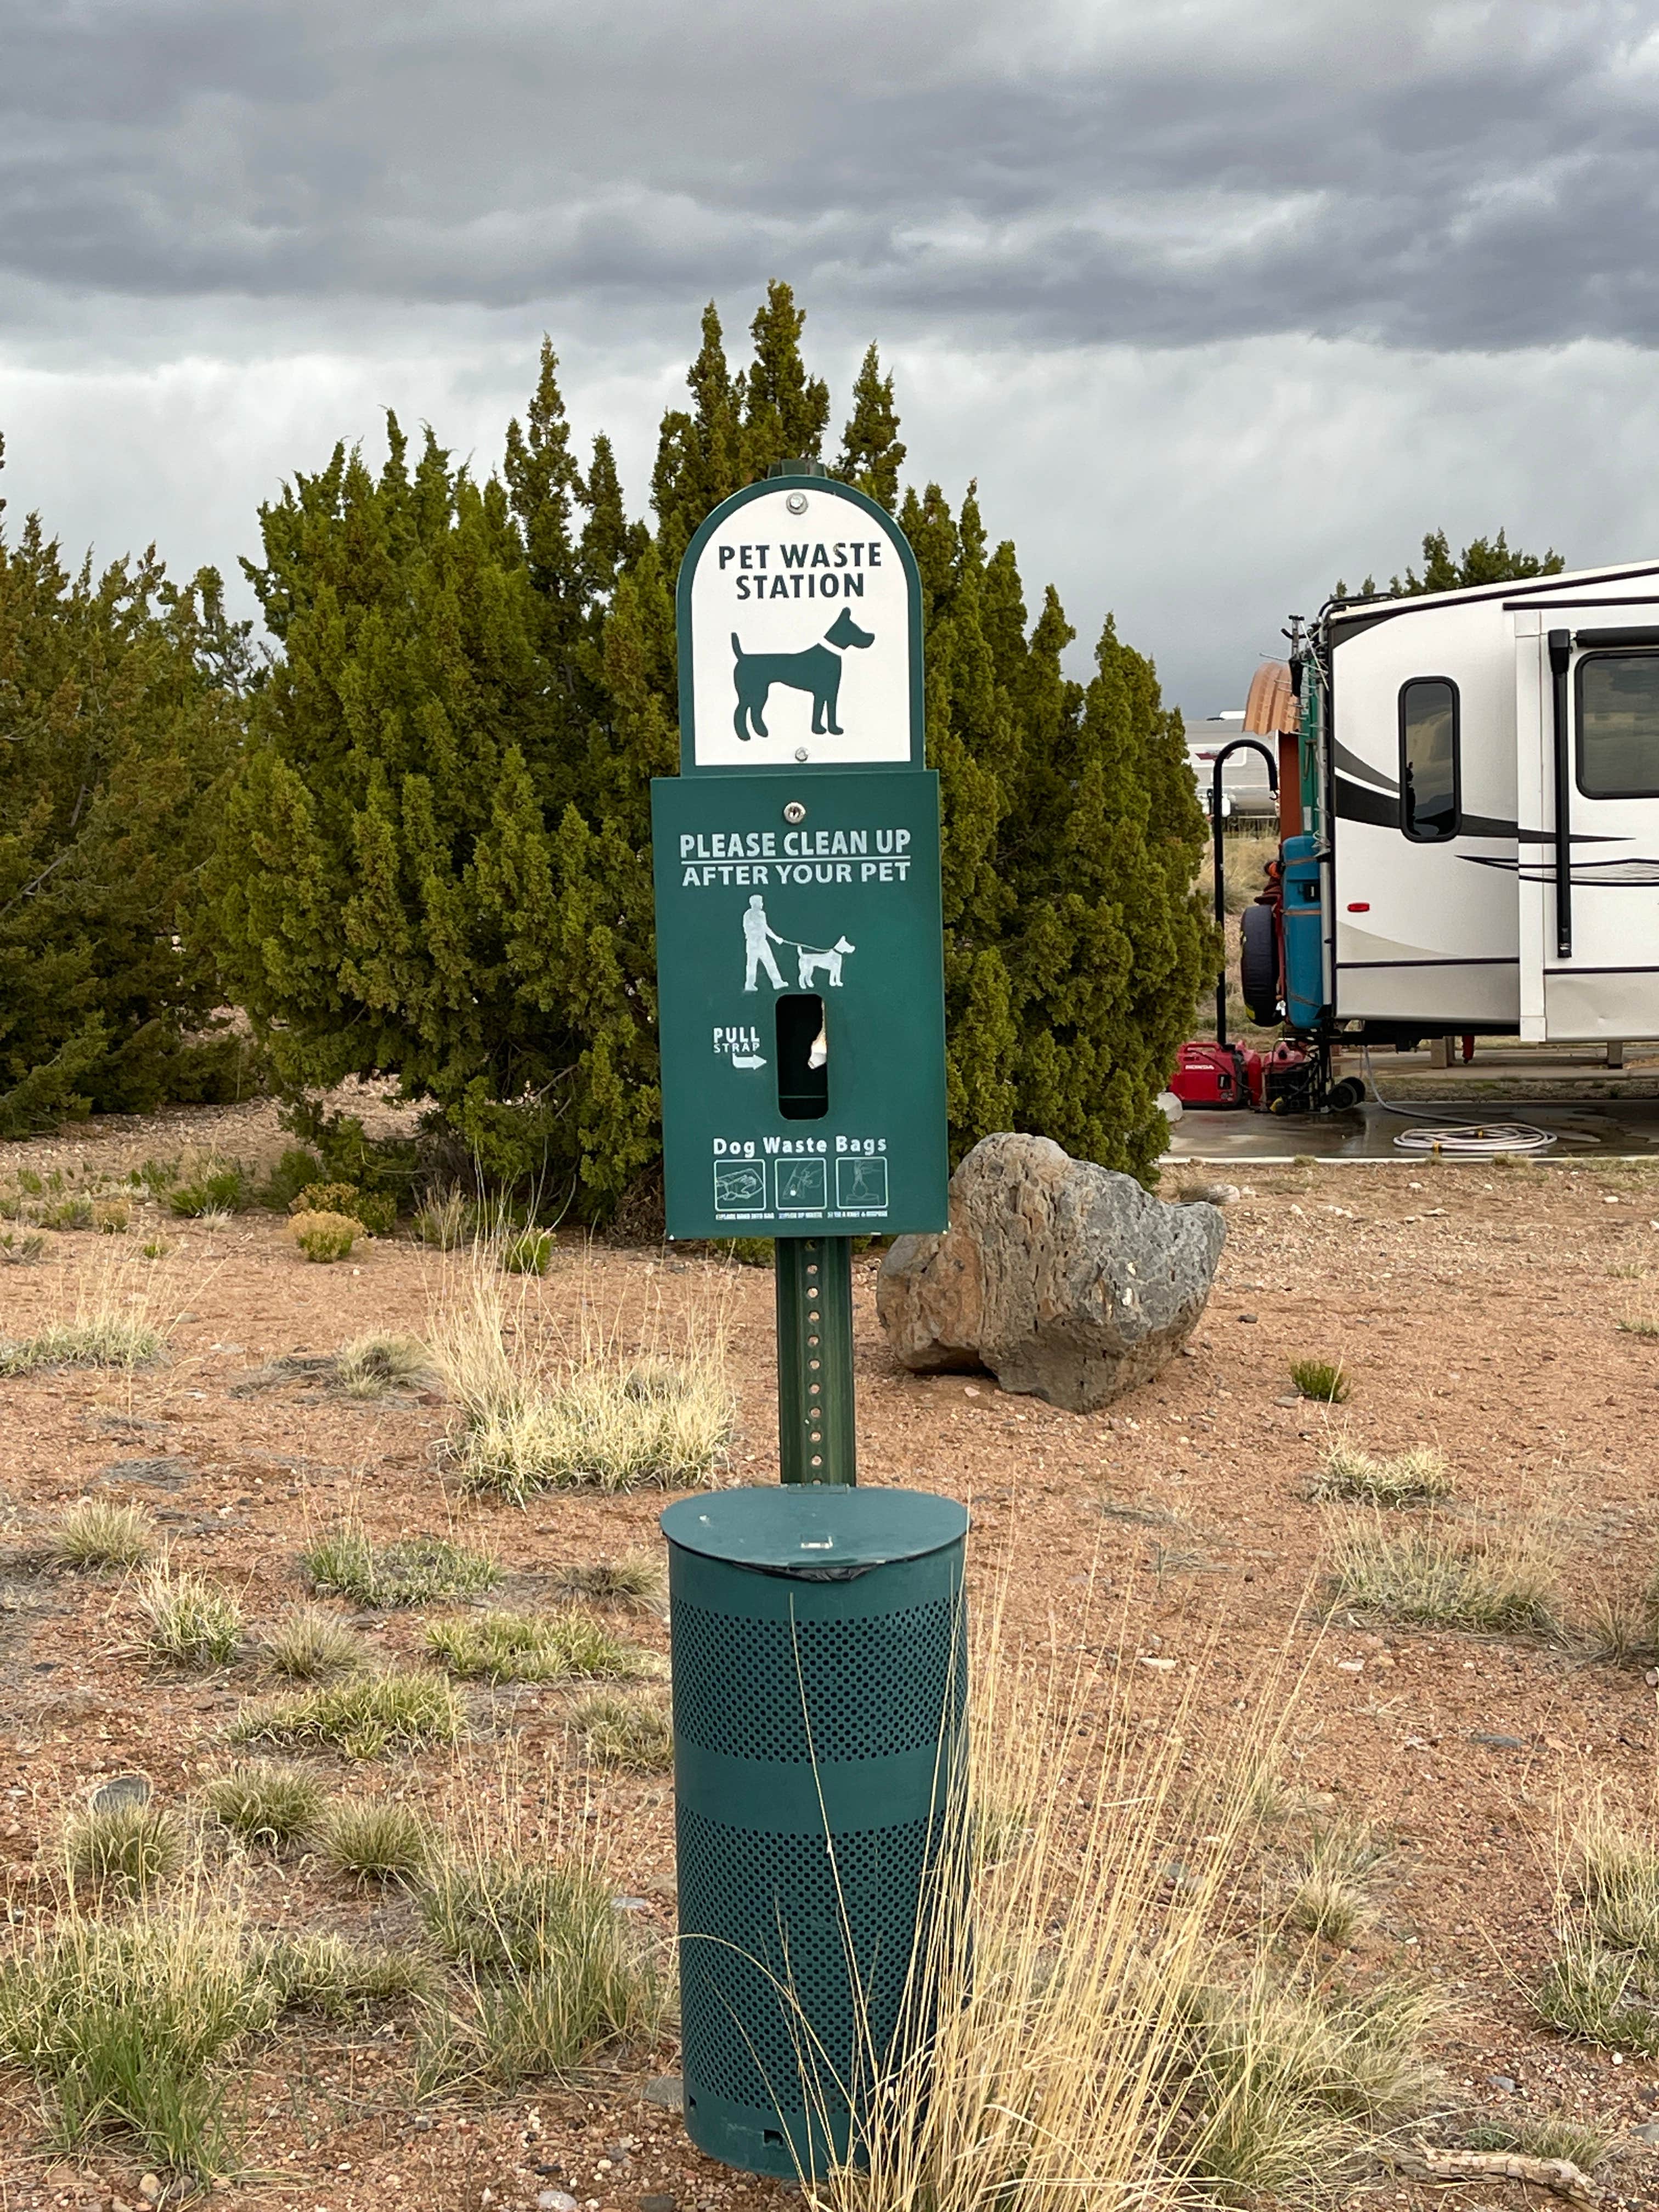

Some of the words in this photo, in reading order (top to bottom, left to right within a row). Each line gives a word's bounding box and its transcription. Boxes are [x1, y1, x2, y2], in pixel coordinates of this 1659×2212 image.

[719, 545, 770, 570] PET
[780, 542, 882, 569] WASTE
[736, 573, 864, 600] STATION
[680, 833, 776, 857] PLEASE
[783, 831, 867, 856] CLEAN
[876, 829, 911, 853] UP
[682, 865, 769, 887] AFTER
[775, 864, 852, 884] YOUR
[861, 862, 911, 882] PET
[714, 1026, 760, 1043] PULL
[714, 1042, 760, 1053] STRAP
[713, 1138, 755, 1158] Dog
[763, 1136, 827, 1154] Waste
[836, 1136, 887, 1155] Bags
